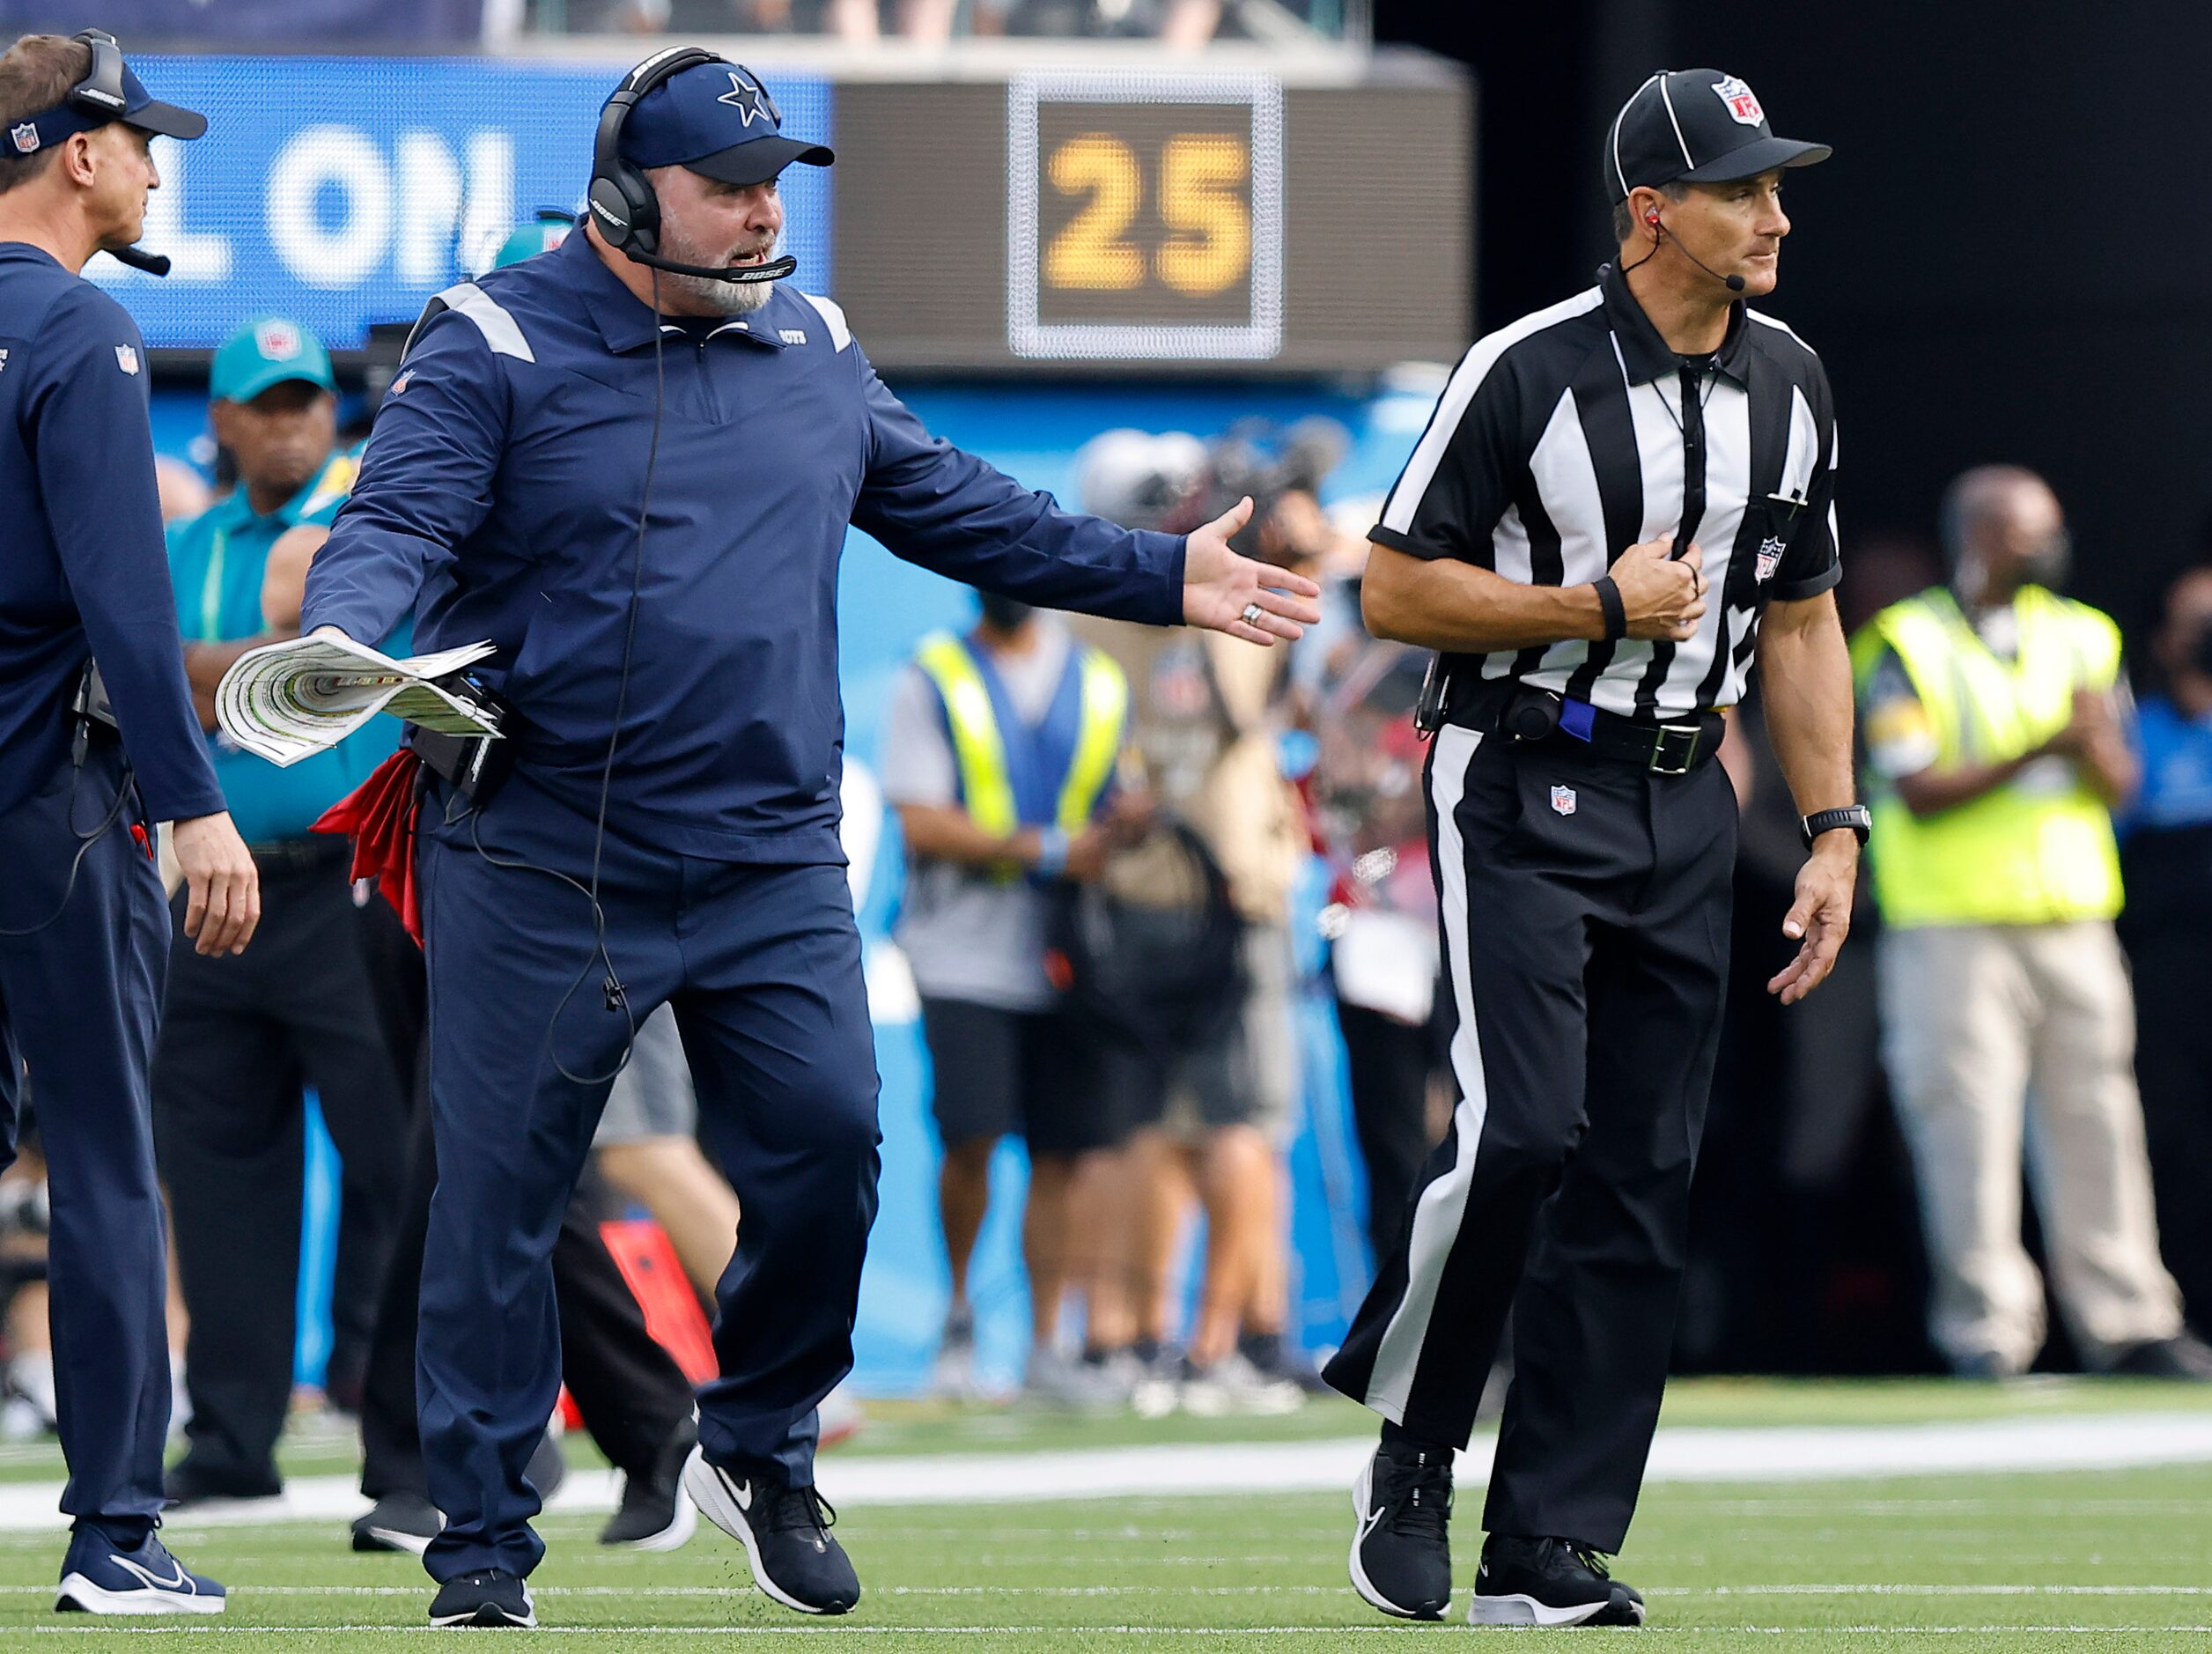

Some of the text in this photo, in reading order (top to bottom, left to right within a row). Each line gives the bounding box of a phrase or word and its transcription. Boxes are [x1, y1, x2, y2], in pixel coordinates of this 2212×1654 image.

[267, 123, 515, 286] ON
[589, 198, 629, 227] BOSE
[1045, 133, 1251, 298] 25
[731, 265, 791, 281] BOSE
